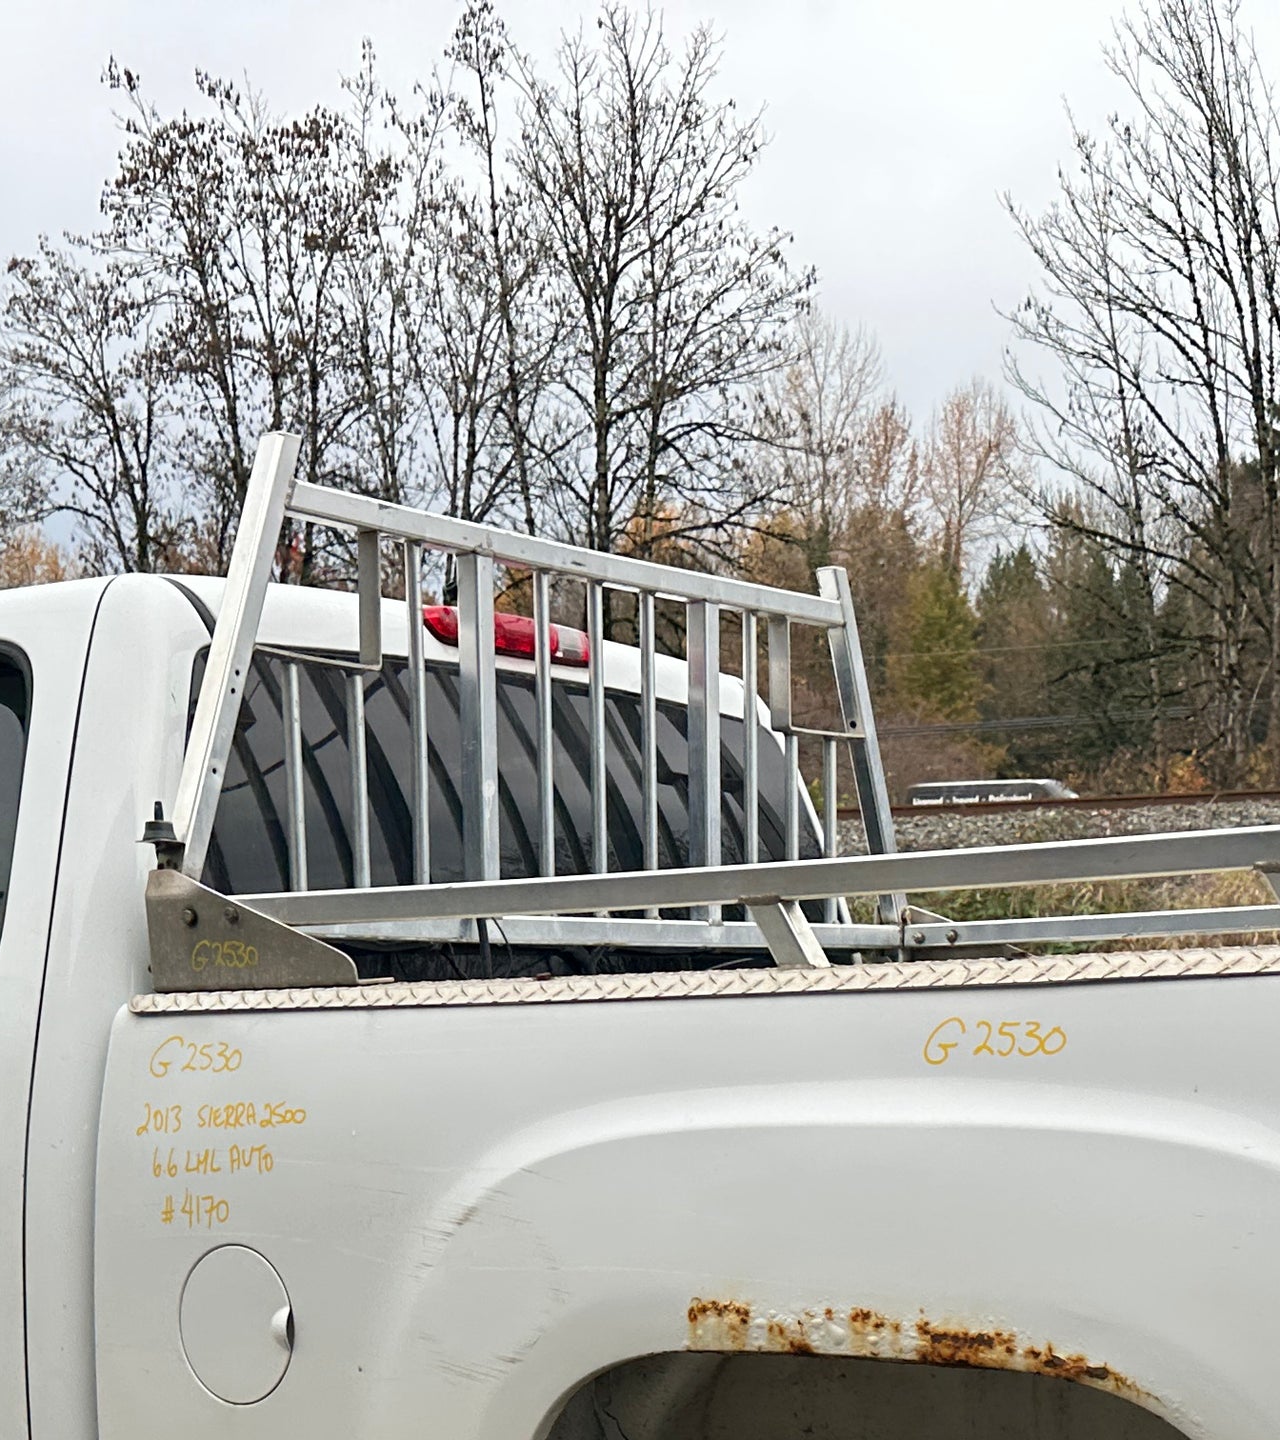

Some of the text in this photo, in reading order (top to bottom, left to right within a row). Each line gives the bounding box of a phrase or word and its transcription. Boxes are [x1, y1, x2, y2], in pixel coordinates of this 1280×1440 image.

[191, 940, 258, 971] G2530
[150, 1036, 242, 1077] G2530
[923, 1016, 1067, 1065] G2530
[136, 1103, 182, 1136] 2013
[185, 1149, 221, 1175] LML
[229, 1144, 274, 1175] AUTO
